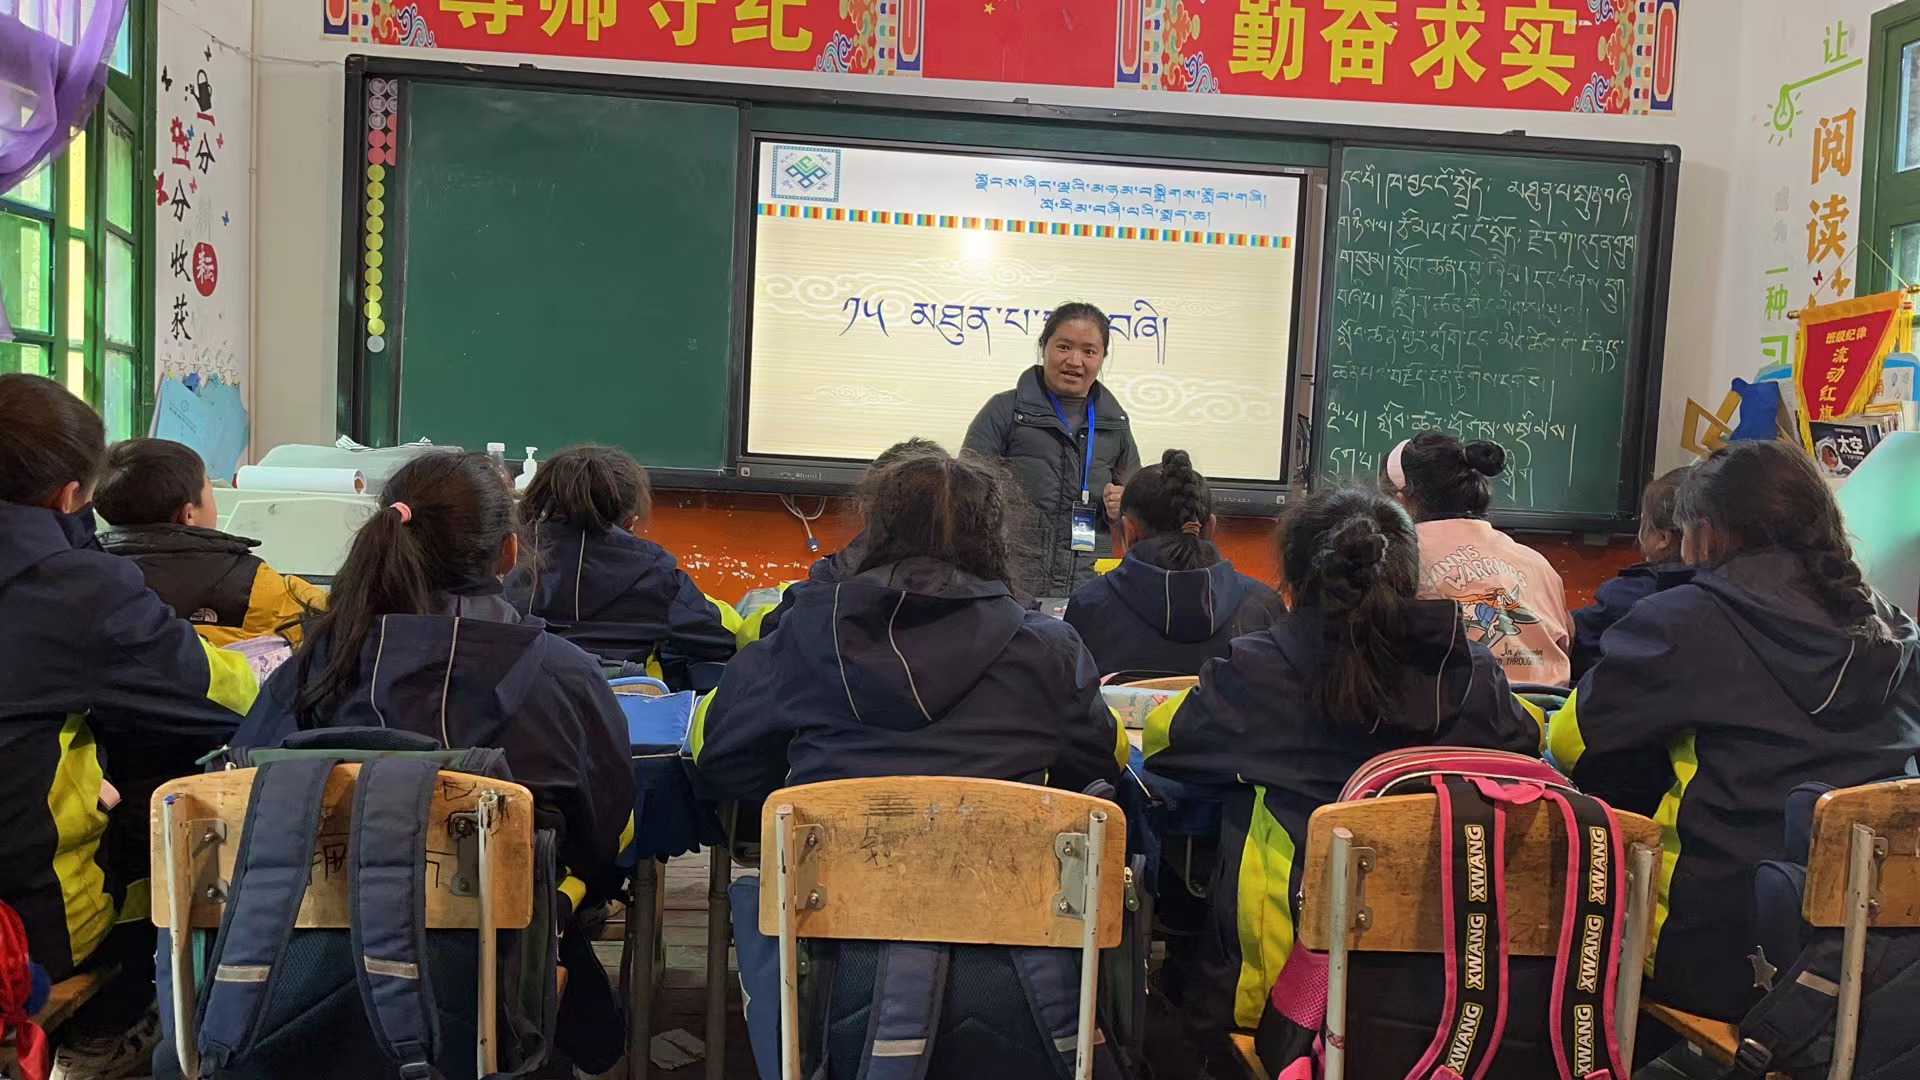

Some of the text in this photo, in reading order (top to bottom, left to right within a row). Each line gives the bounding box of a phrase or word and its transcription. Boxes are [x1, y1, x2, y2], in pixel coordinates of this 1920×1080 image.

[1229, 0, 1576, 95] 勤奋求实
[1823, 19, 1849, 63] 让
[1807, 107, 1856, 264] 阅读
[1837, 434, 1865, 455] 太空
[1466, 825, 1486, 901] XWANG
[1589, 826, 1606, 903] XWANG
[1466, 914, 1486, 989] XWANG
[1577, 915, 1603, 992] XWANG
[1446, 1003, 1482, 1073] XWANG
[1575, 1005, 1593, 1076] XWANG
